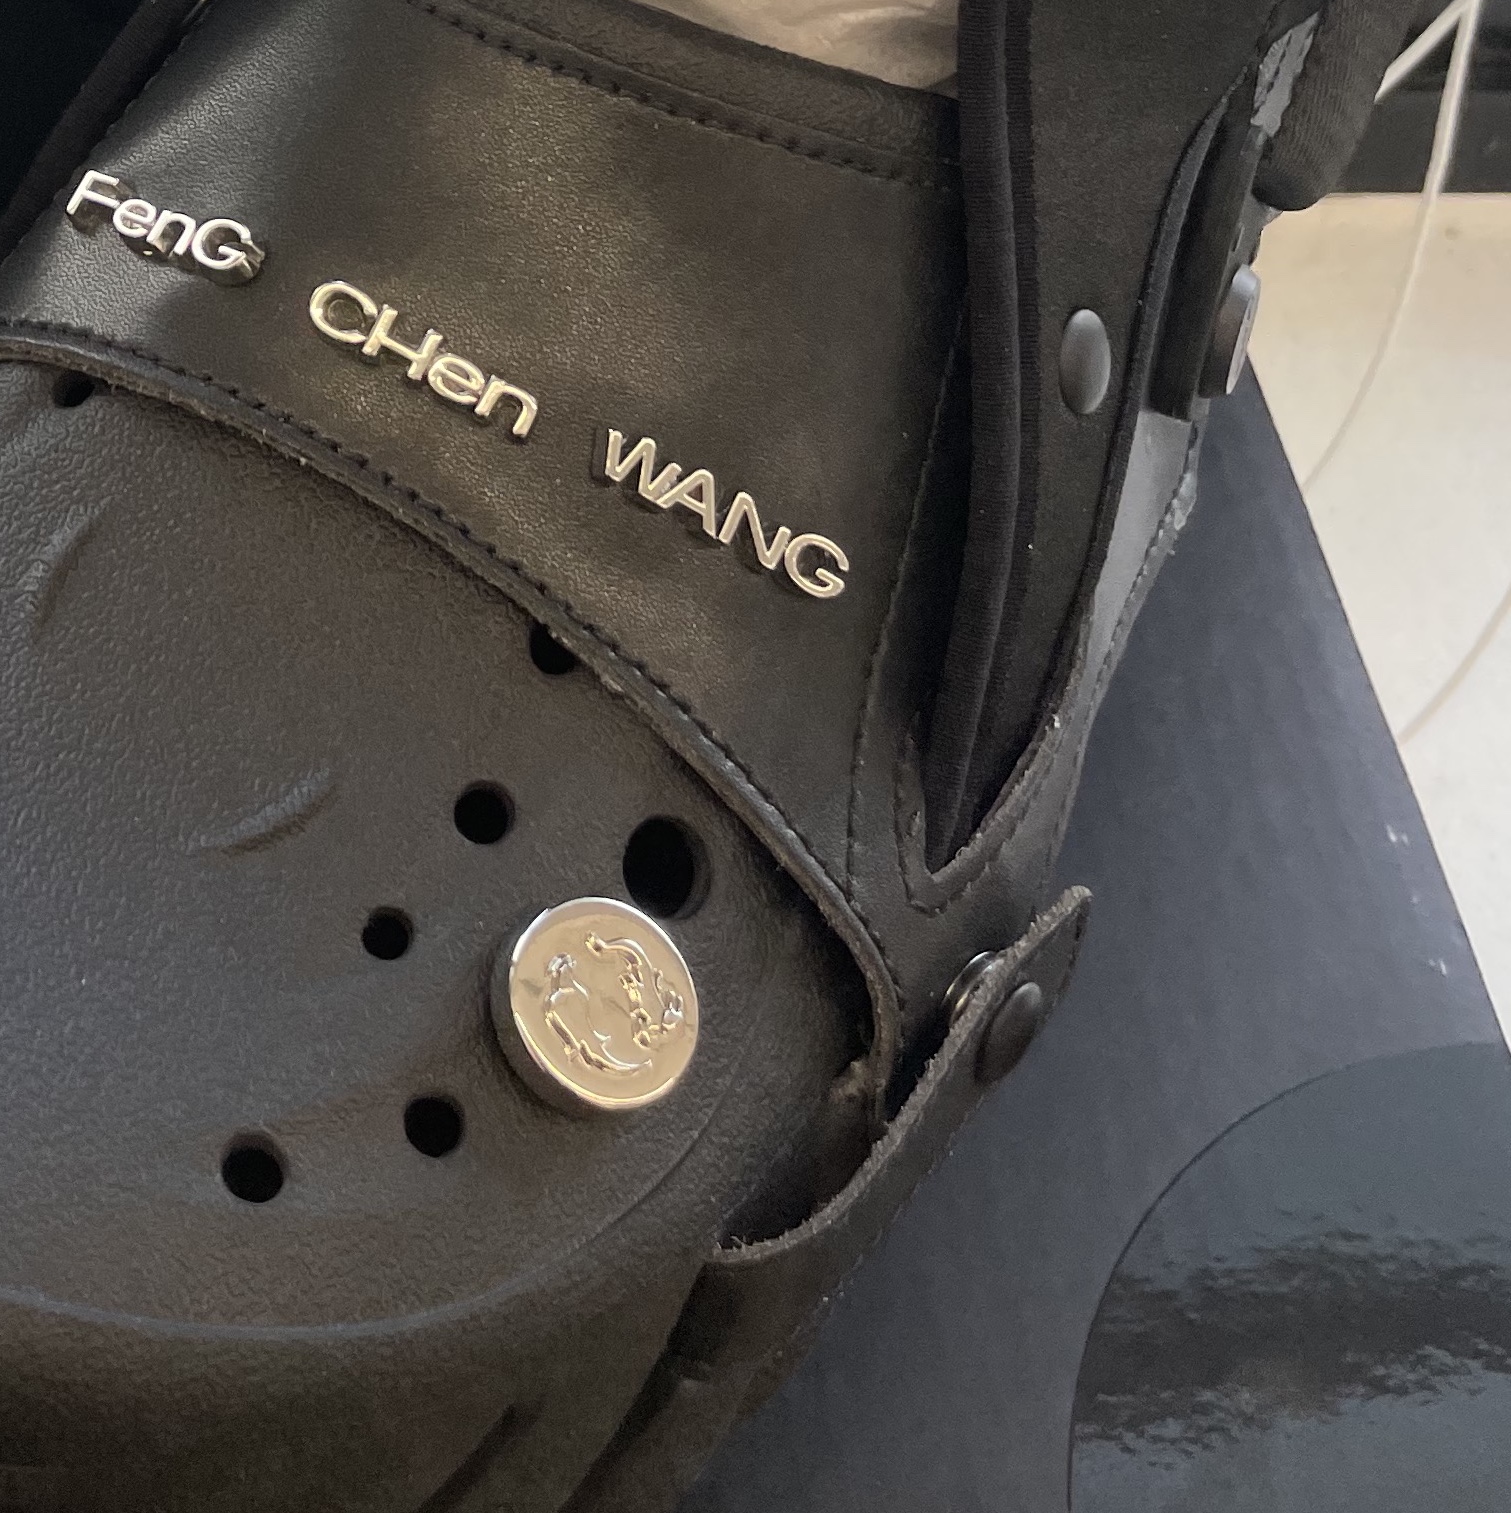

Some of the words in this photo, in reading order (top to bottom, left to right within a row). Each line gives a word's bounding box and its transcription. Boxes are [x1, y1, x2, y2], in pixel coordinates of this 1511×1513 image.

[65, 170, 264, 272] FenG
[308, 280, 540, 438] CHen
[604, 428, 850, 598] WANG
